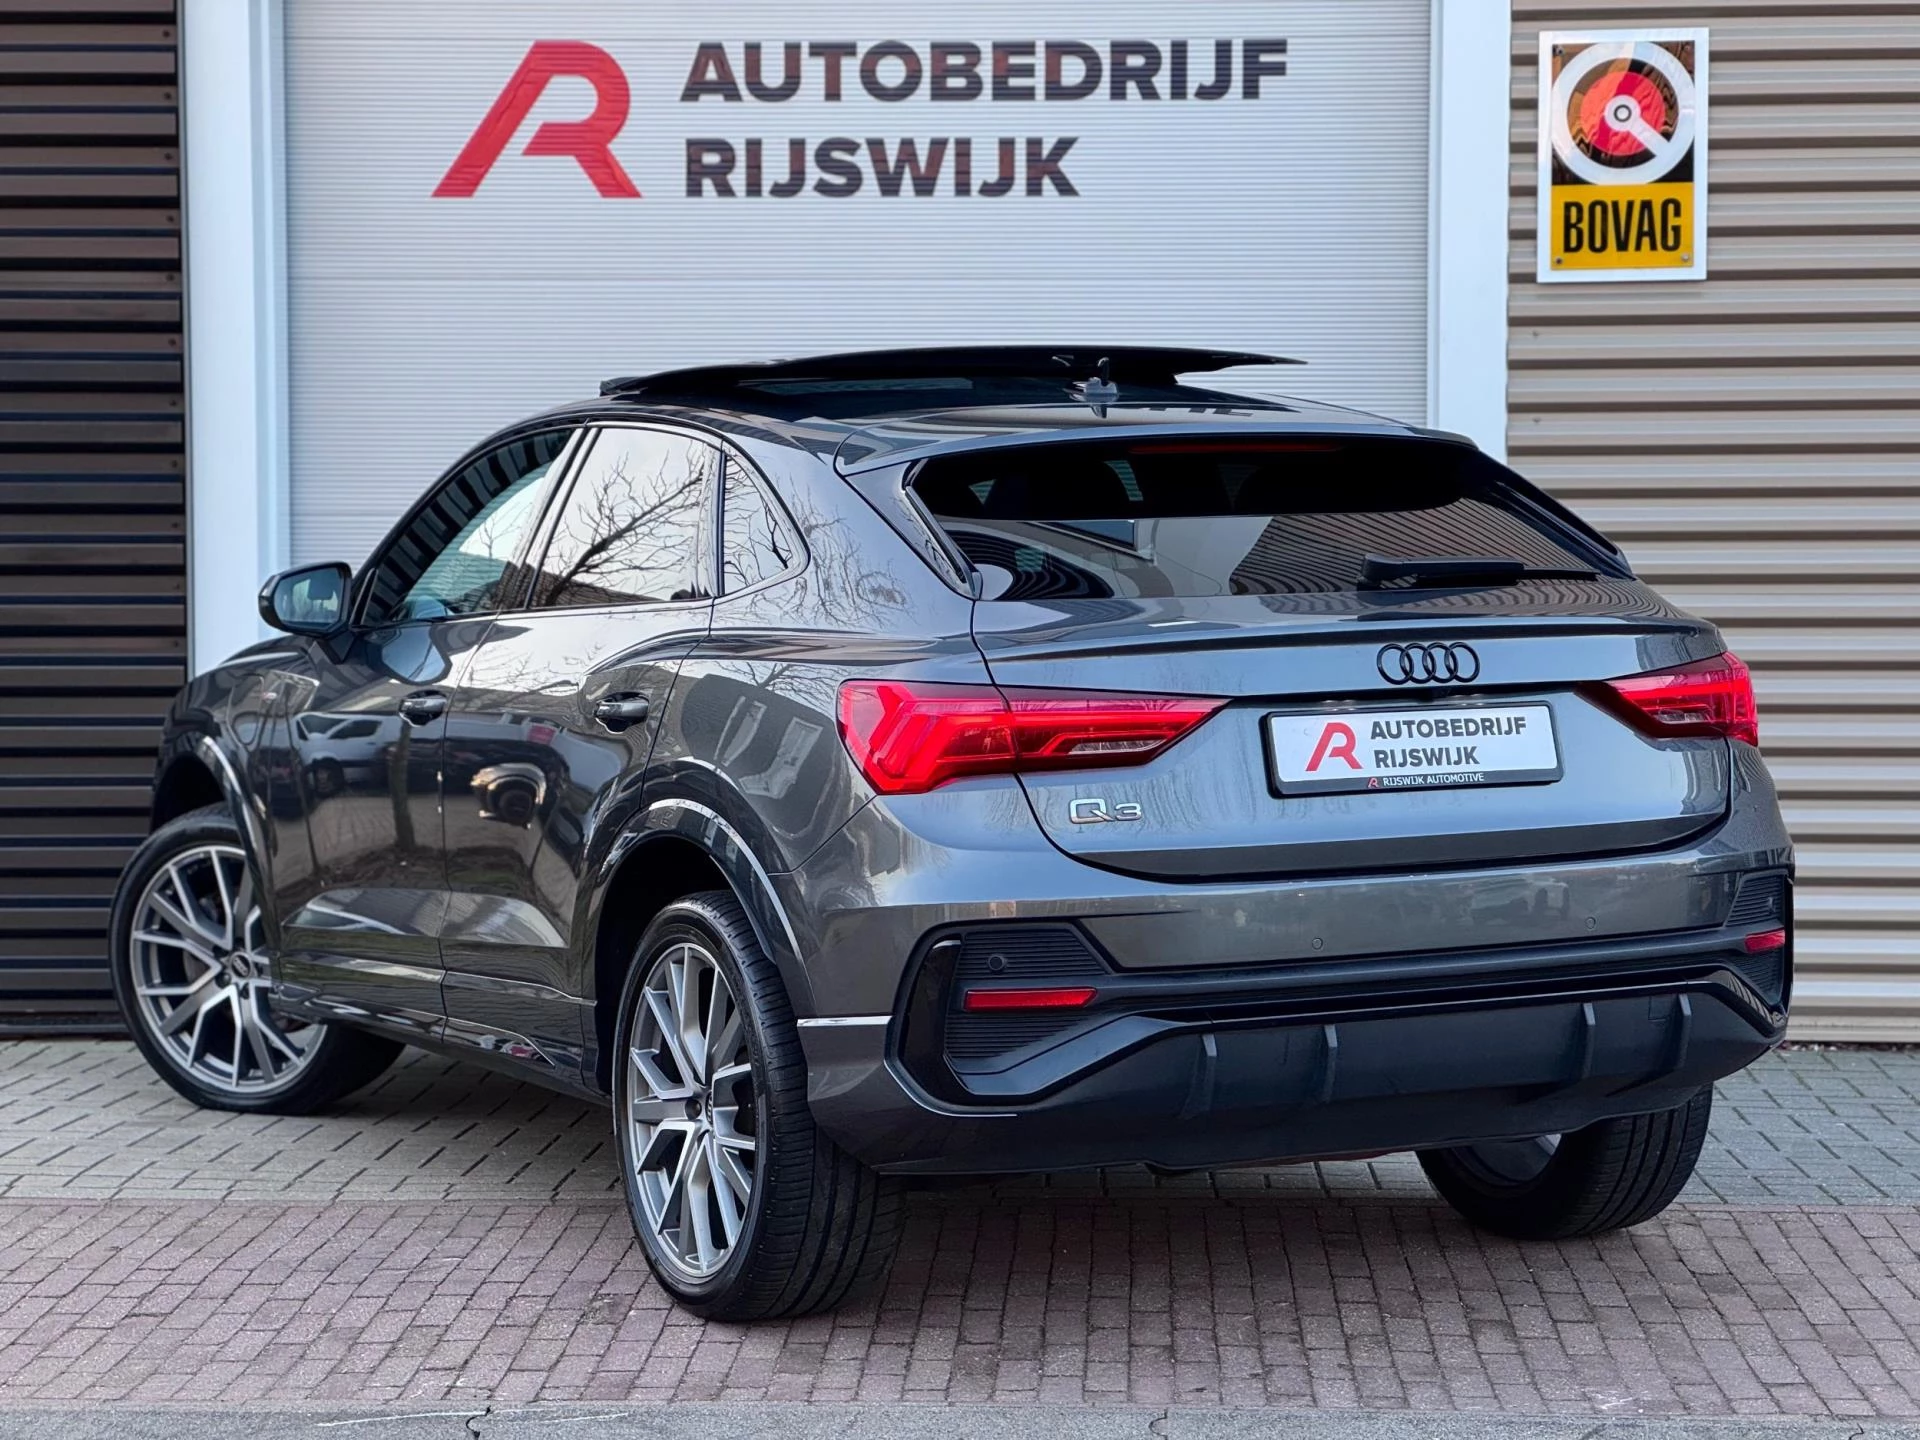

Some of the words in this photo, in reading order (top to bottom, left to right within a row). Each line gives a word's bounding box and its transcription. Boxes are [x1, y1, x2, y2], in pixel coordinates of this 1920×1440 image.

[680, 38, 1288, 103] AUTOBEDRIJF
[685, 136, 1080, 198] RIJSWIJK
[1563, 198, 1682, 254] BOVAG
[1370, 716, 1527, 740] AUTOBEDRIJF
[1374, 746, 1480, 769] RIJSWIJK
[1382, 775, 1425, 786] RIJSWIJK
[1426, 772, 1485, 785] AUTOMOTIVE
[1069, 798, 1142, 824] Q3
